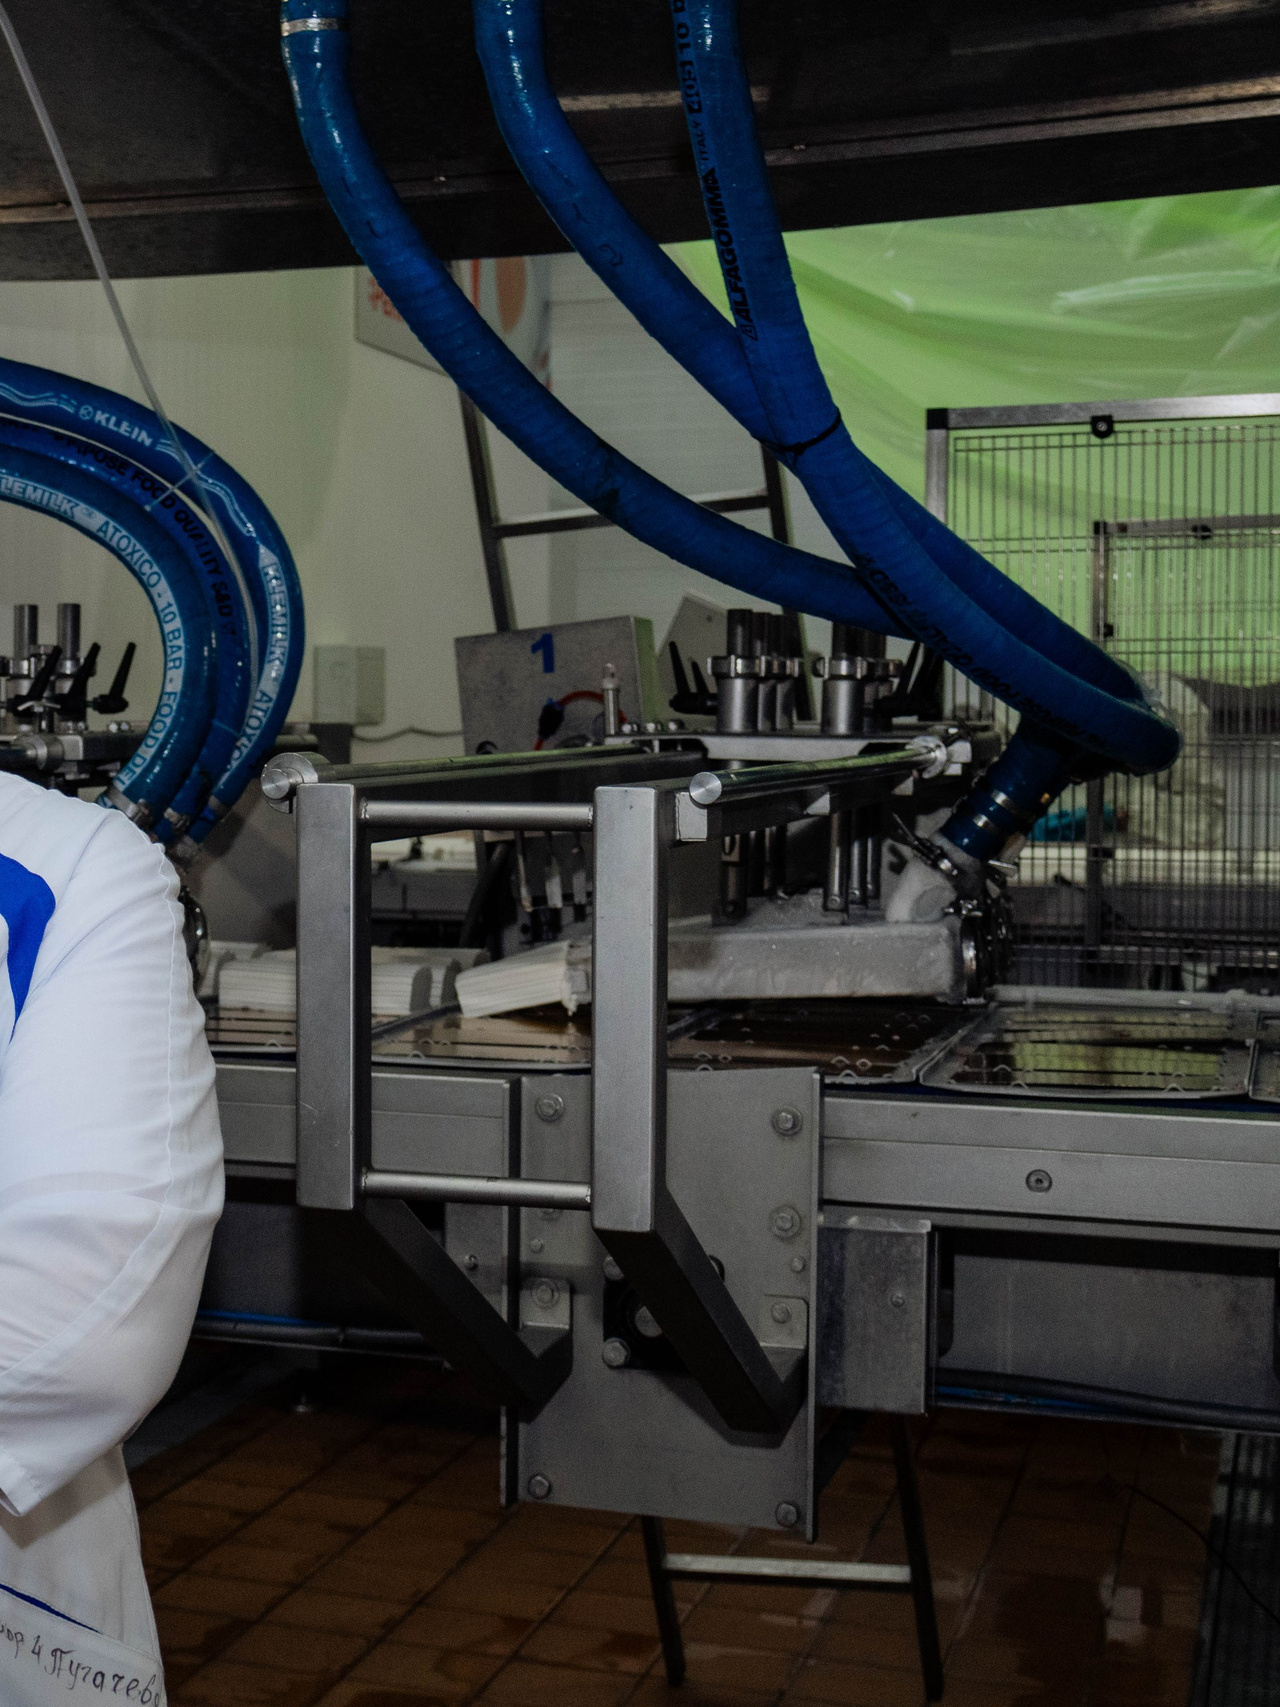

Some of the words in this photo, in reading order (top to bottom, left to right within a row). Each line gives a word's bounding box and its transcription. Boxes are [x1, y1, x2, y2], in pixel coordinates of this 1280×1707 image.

[676, 22, 691, 54] 10
[680, 60, 702, 113] 405
[691, 121, 710, 161] ITALY
[703, 167, 754, 323] ALFAGOMMA
[93, 410, 154, 447] KLEIN
[131, 470, 176, 509] FOOD
[174, 510, 224, 576] QUALITY
[96, 520, 163, 589] ATOXICO
[159, 601, 177, 625] 10
[263, 563, 288, 667] KLEMILK
[166, 627, 183, 671] BAR
[530, 632, 555, 673] 1
[144, 691, 178, 750] FOOD
